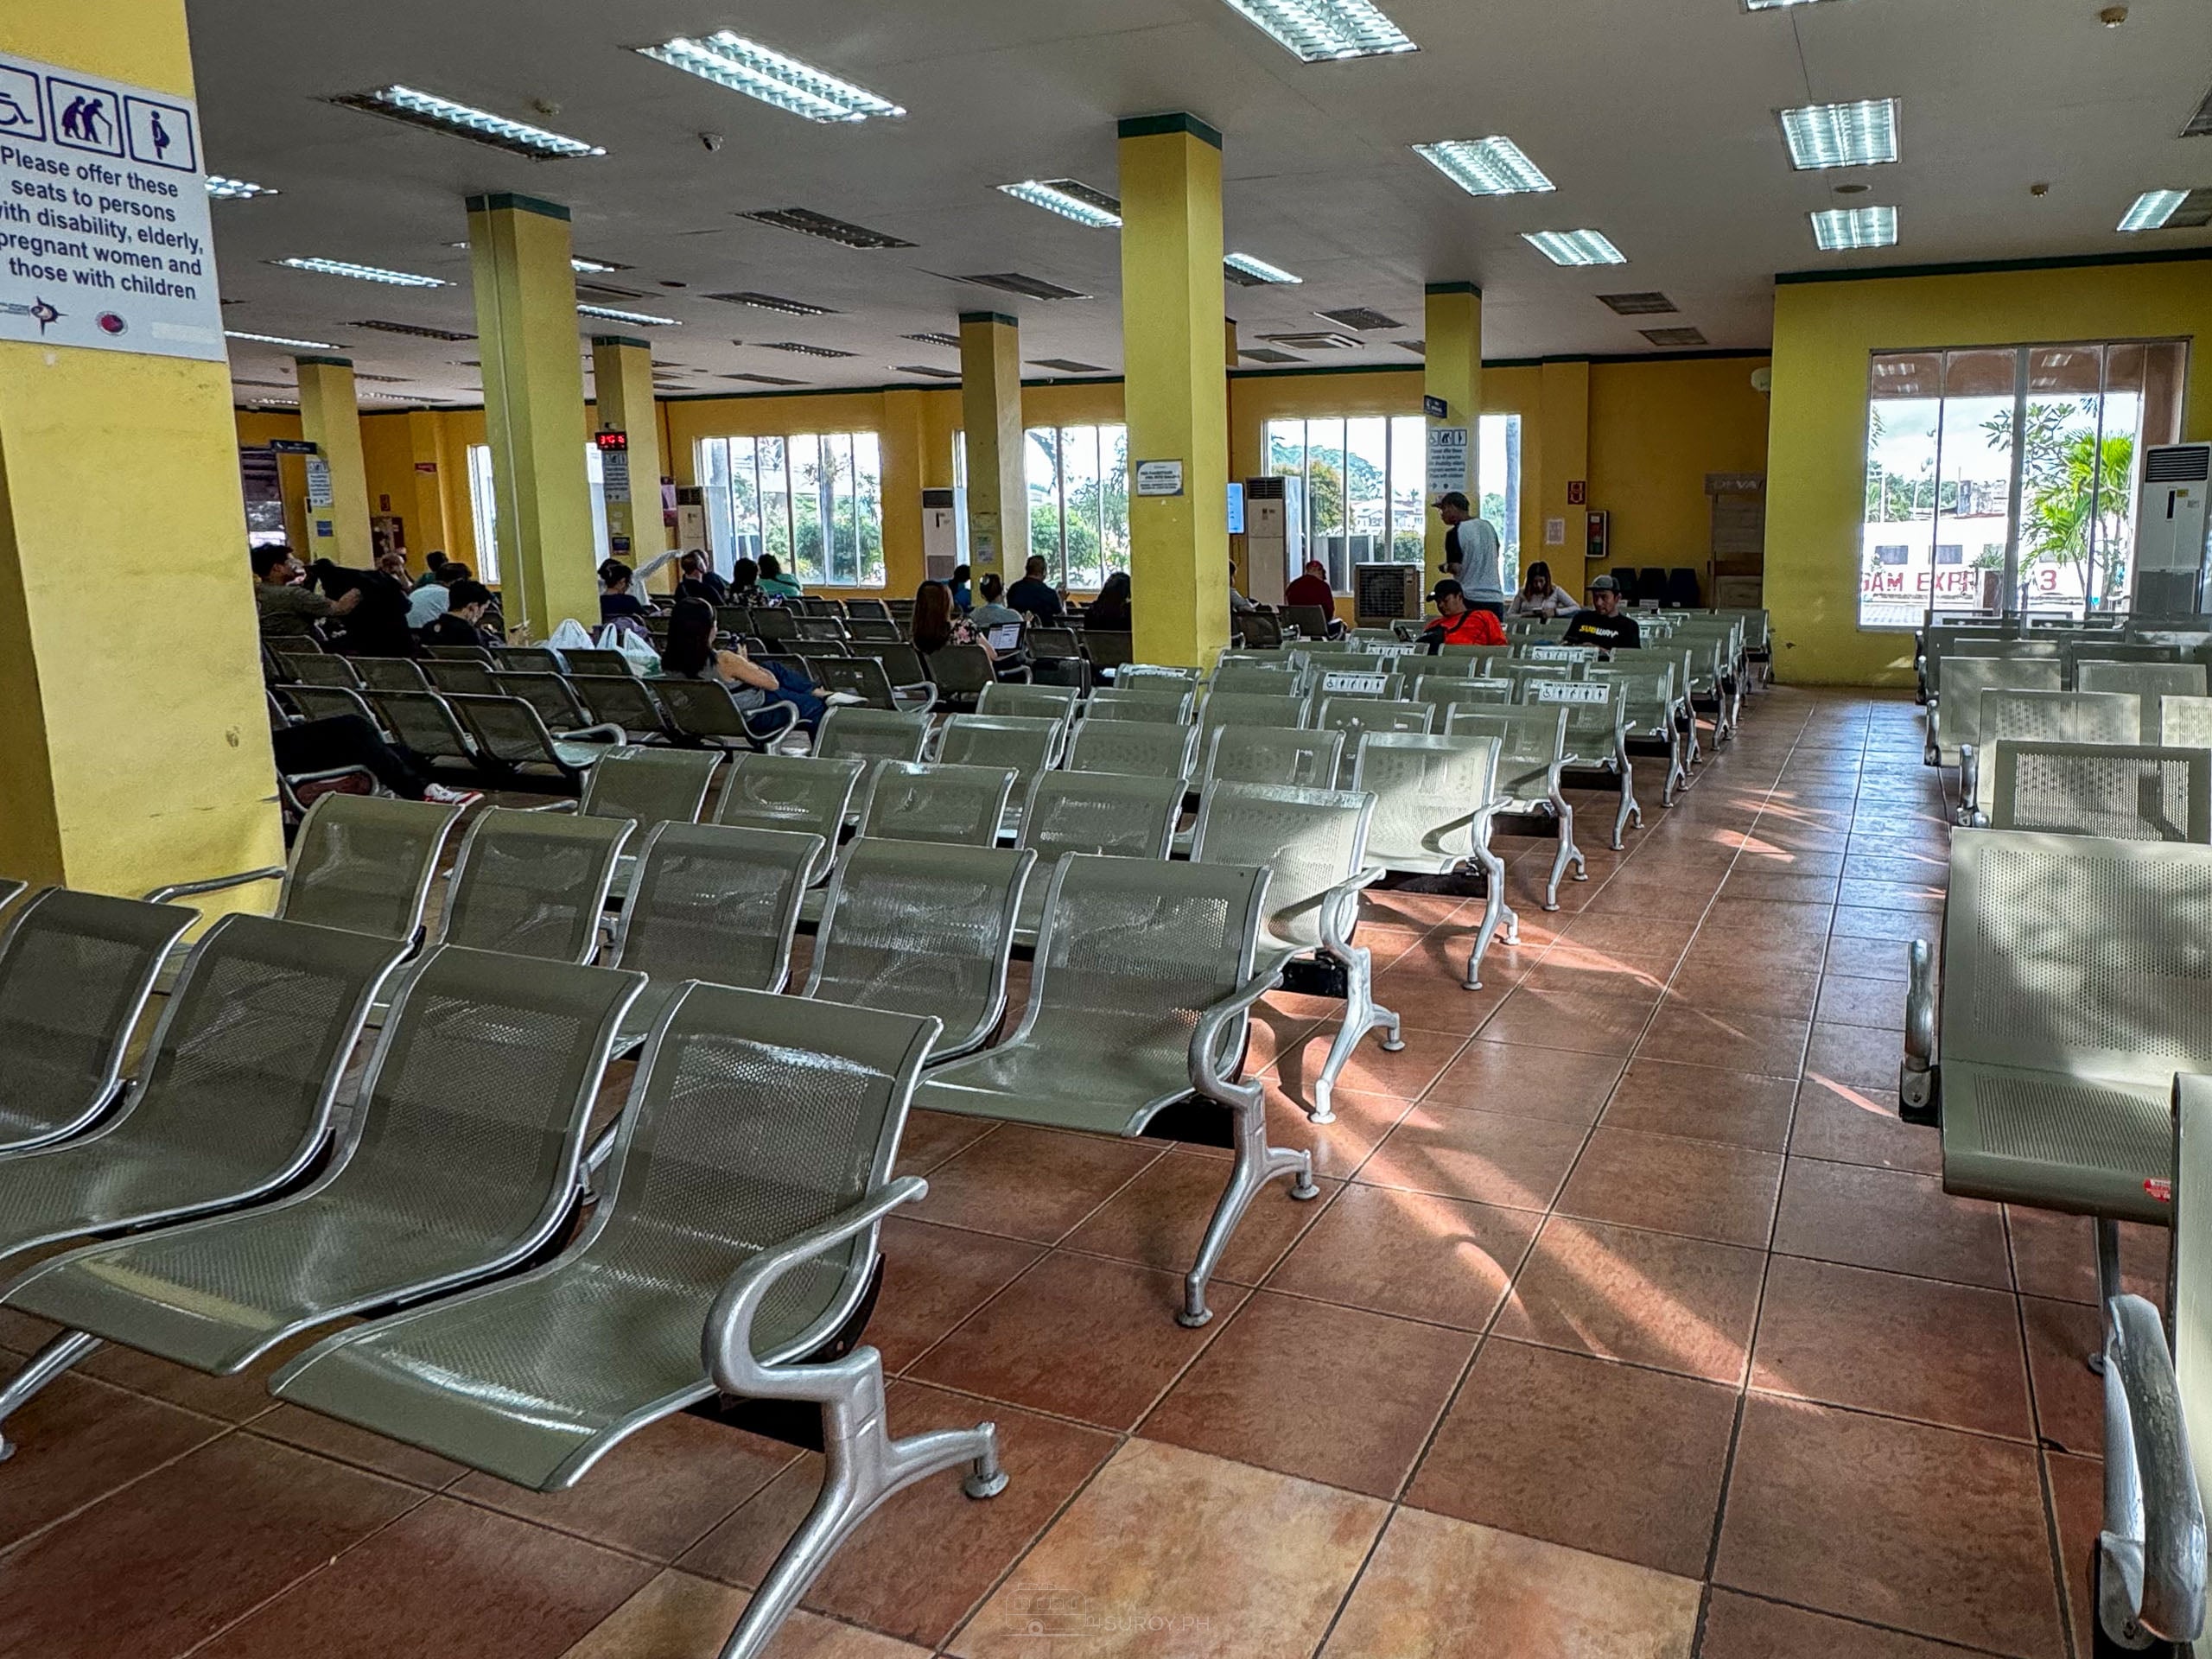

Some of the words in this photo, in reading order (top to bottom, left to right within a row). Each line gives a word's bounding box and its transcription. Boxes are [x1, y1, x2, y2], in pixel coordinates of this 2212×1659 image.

[1, 145, 70, 176] Please
[77, 163, 122, 186] offer
[127, 172, 179, 198] these
[11, 179, 67, 203] seats
[73, 188, 93, 207] to
[99, 195, 176, 222] persons
[0, 200, 31, 224] ith
[37, 207, 132, 244] disability,
[137, 226, 204, 255] elderly,
[0, 232, 89, 259] pregnant
[93, 246, 162, 270] women
[168, 258, 202, 276] and
[9, 257, 68, 282] those
[73, 267, 116, 289] with
[121, 273, 196, 300] children
[1579, 625, 1619, 639] SUBWAY
